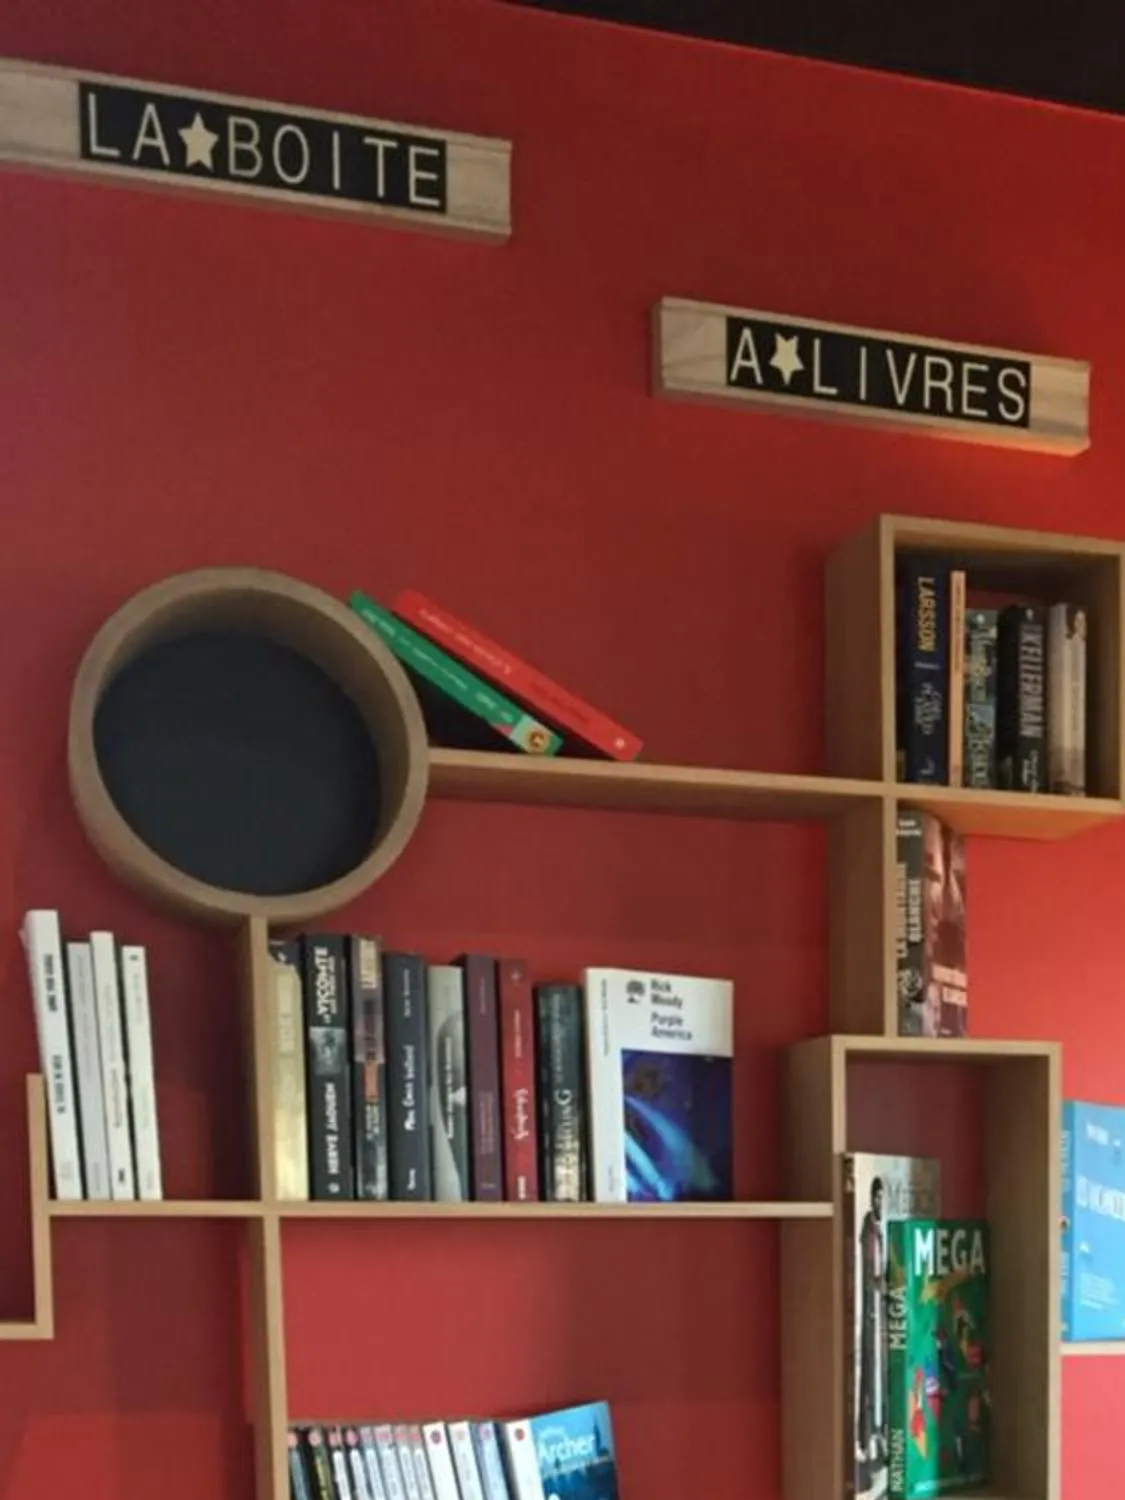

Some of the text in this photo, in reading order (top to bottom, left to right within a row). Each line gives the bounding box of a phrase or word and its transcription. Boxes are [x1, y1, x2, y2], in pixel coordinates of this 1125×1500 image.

[88, 92, 440, 207] LA BOITE
[730, 327, 1027, 422] A LIVRES
[917, 576, 936, 652] LARSSON
[1018, 635, 1043, 739] KELLERMAN
[913, 1227, 985, 1276] MEGA
[889, 1285, 908, 1494] NATHAN MEGA
[536, 1436, 594, 1463] Archer
